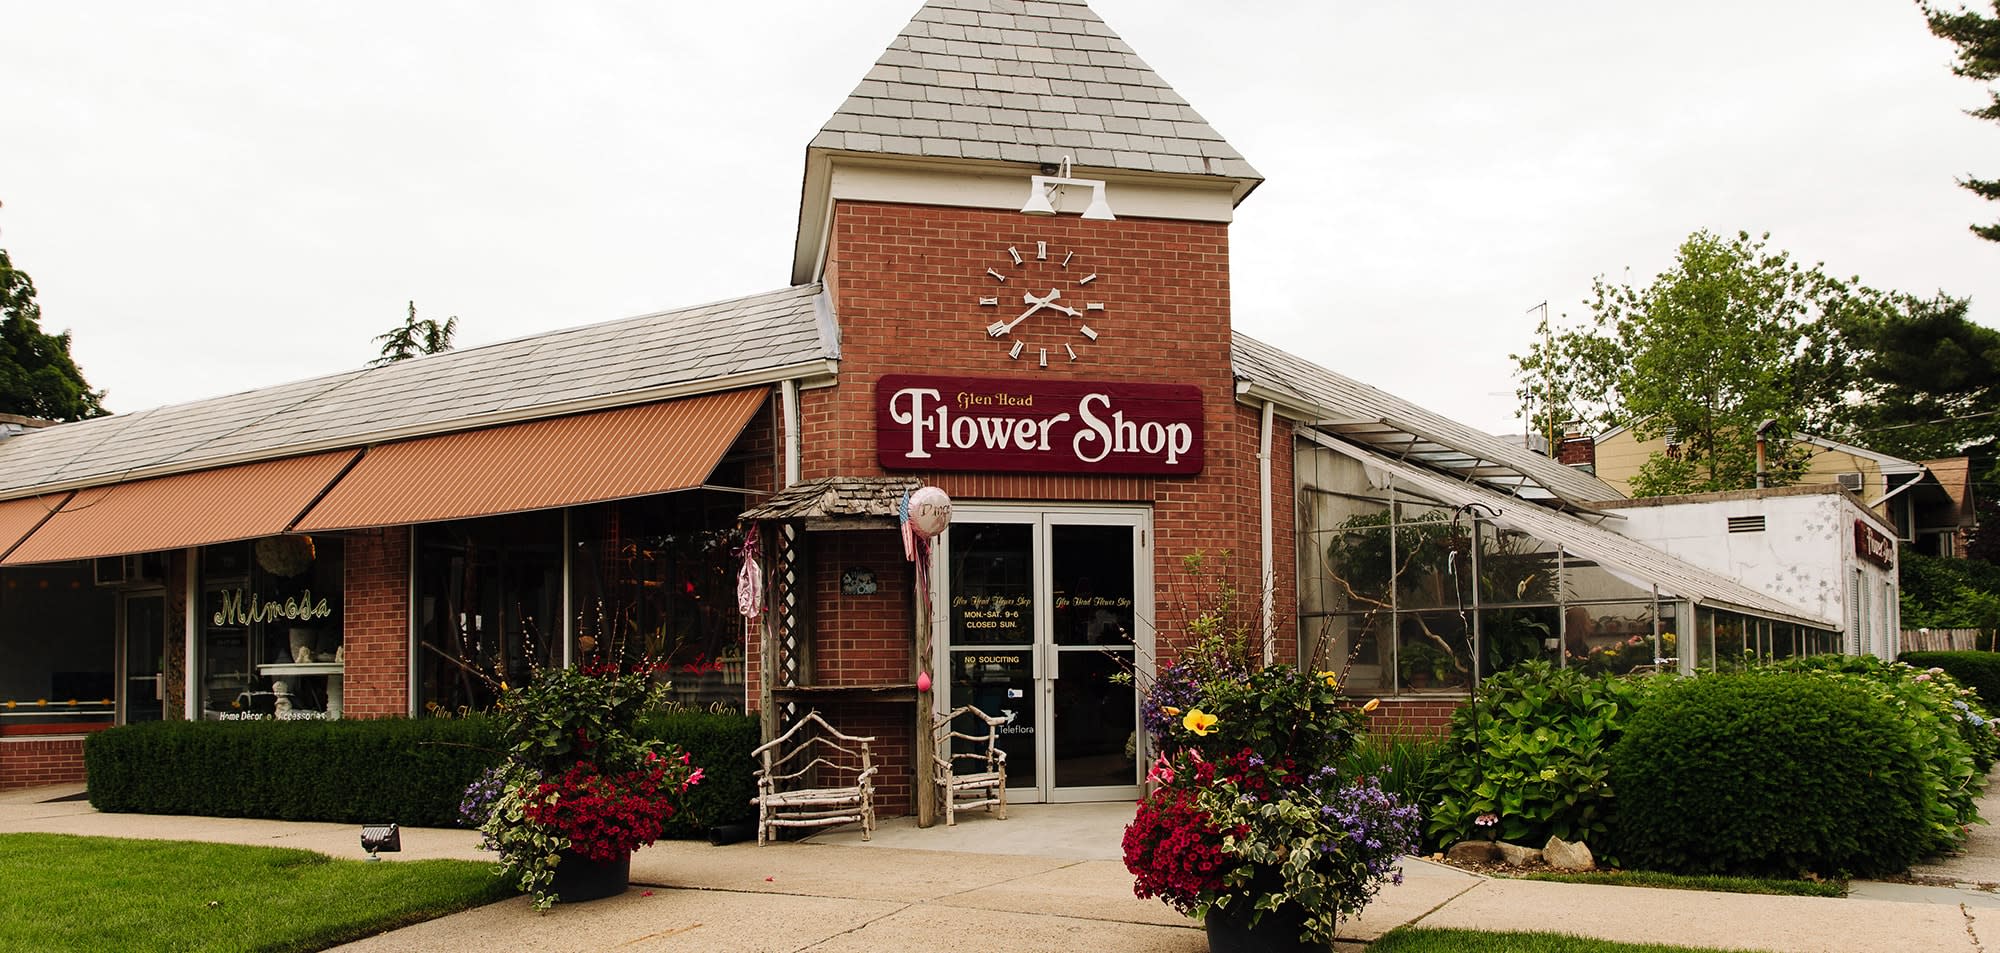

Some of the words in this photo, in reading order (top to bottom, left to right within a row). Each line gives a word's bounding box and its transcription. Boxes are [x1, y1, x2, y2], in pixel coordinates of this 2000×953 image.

[957, 392, 992, 409] Glen
[995, 393, 1033, 406] Head
[889, 387, 1071, 459] Flower
[1072, 393, 1193, 464] Shop
[214, 588, 331, 625] Mimosa
[964, 611, 1003, 619] MON.-SAT.
[966, 621, 997, 629] CLOSED
[999, 621, 1017, 629] SUN.
[964, 656, 976, 664] NO
[978, 656, 1020, 664] SOLICITING
[219, 711, 240, 721] Home
[999, 725, 1034, 734] Teleflora
